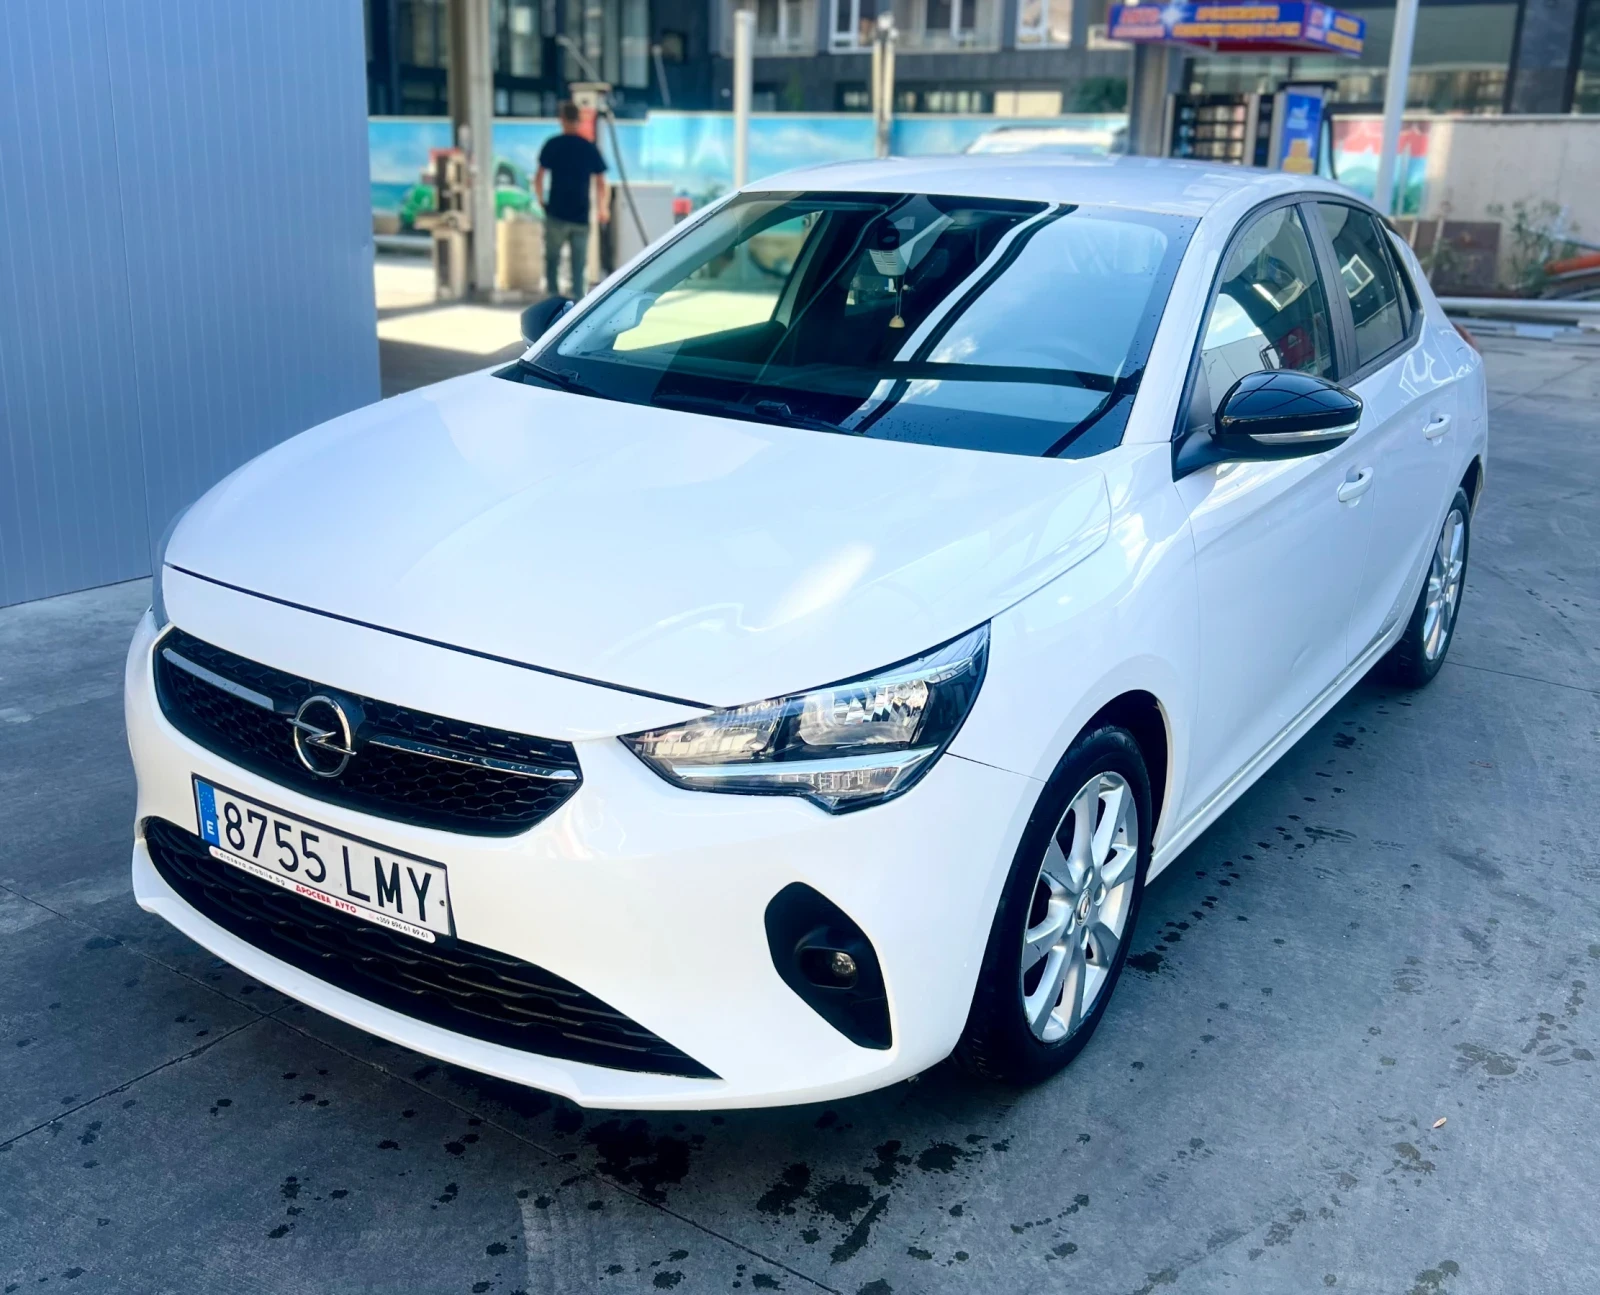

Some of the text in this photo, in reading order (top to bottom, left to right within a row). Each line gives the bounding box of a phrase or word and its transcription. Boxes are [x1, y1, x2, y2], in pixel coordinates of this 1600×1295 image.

[206, 802, 432, 922] E 8755 LMY
[295, 884, 357, 914] ДРОСЕВА АУТО
